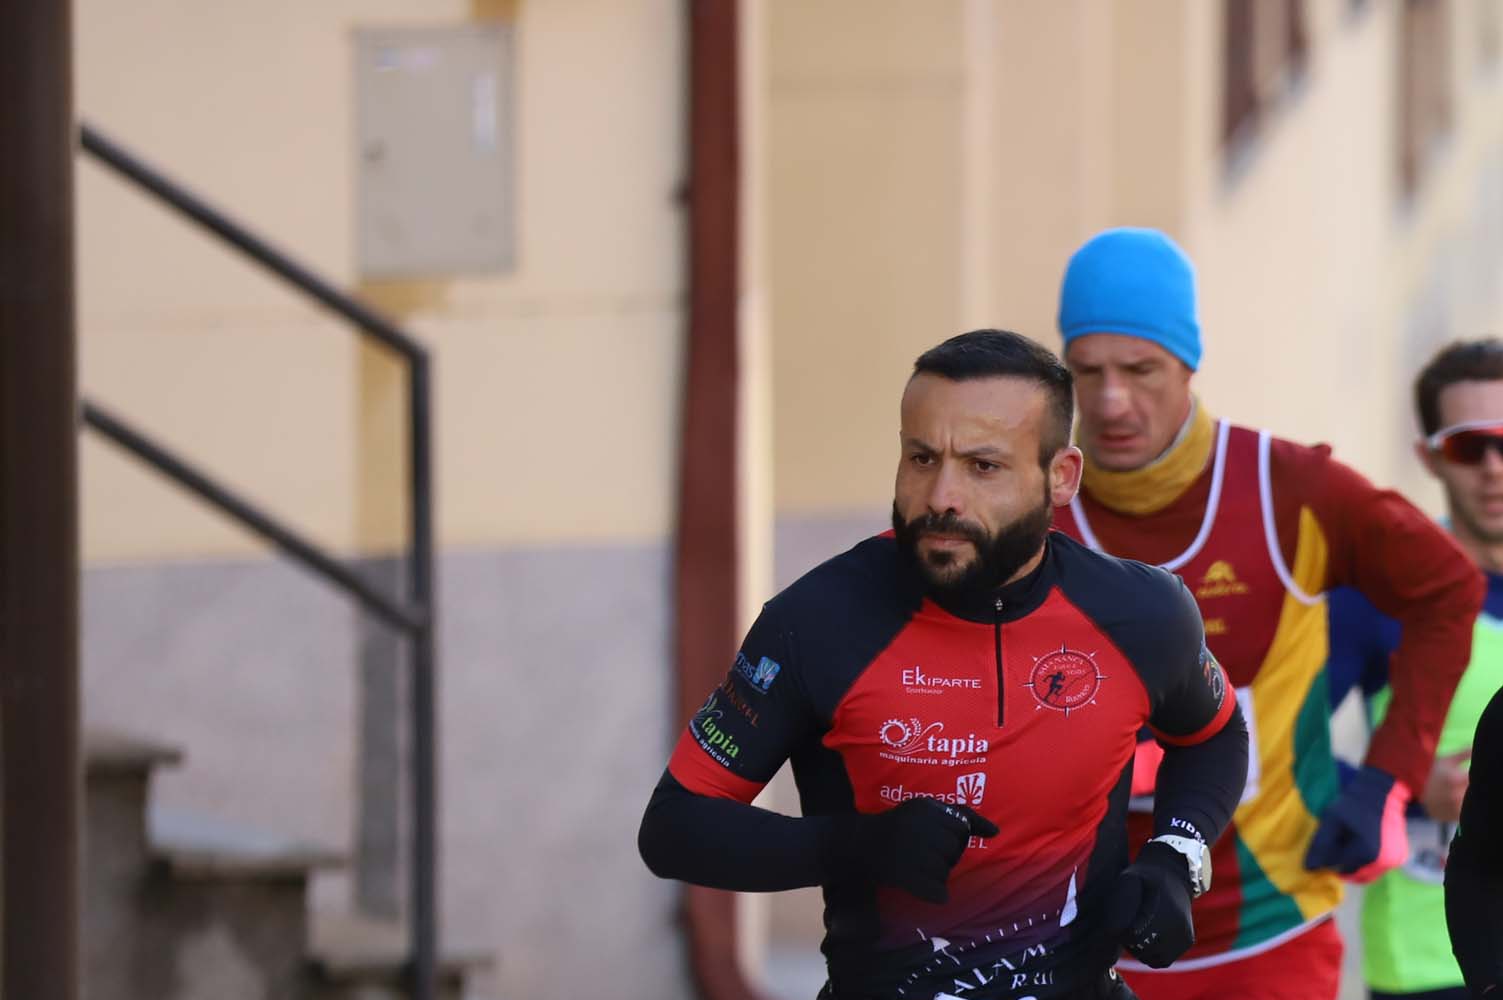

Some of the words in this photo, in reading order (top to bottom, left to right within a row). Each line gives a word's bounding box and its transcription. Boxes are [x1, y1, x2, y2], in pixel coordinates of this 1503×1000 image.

[701, 716, 741, 758] tapia
[927, 733, 989, 758] tapia
[880, 752, 938, 766] maquinaria
[941, 756, 987, 766] agricola
